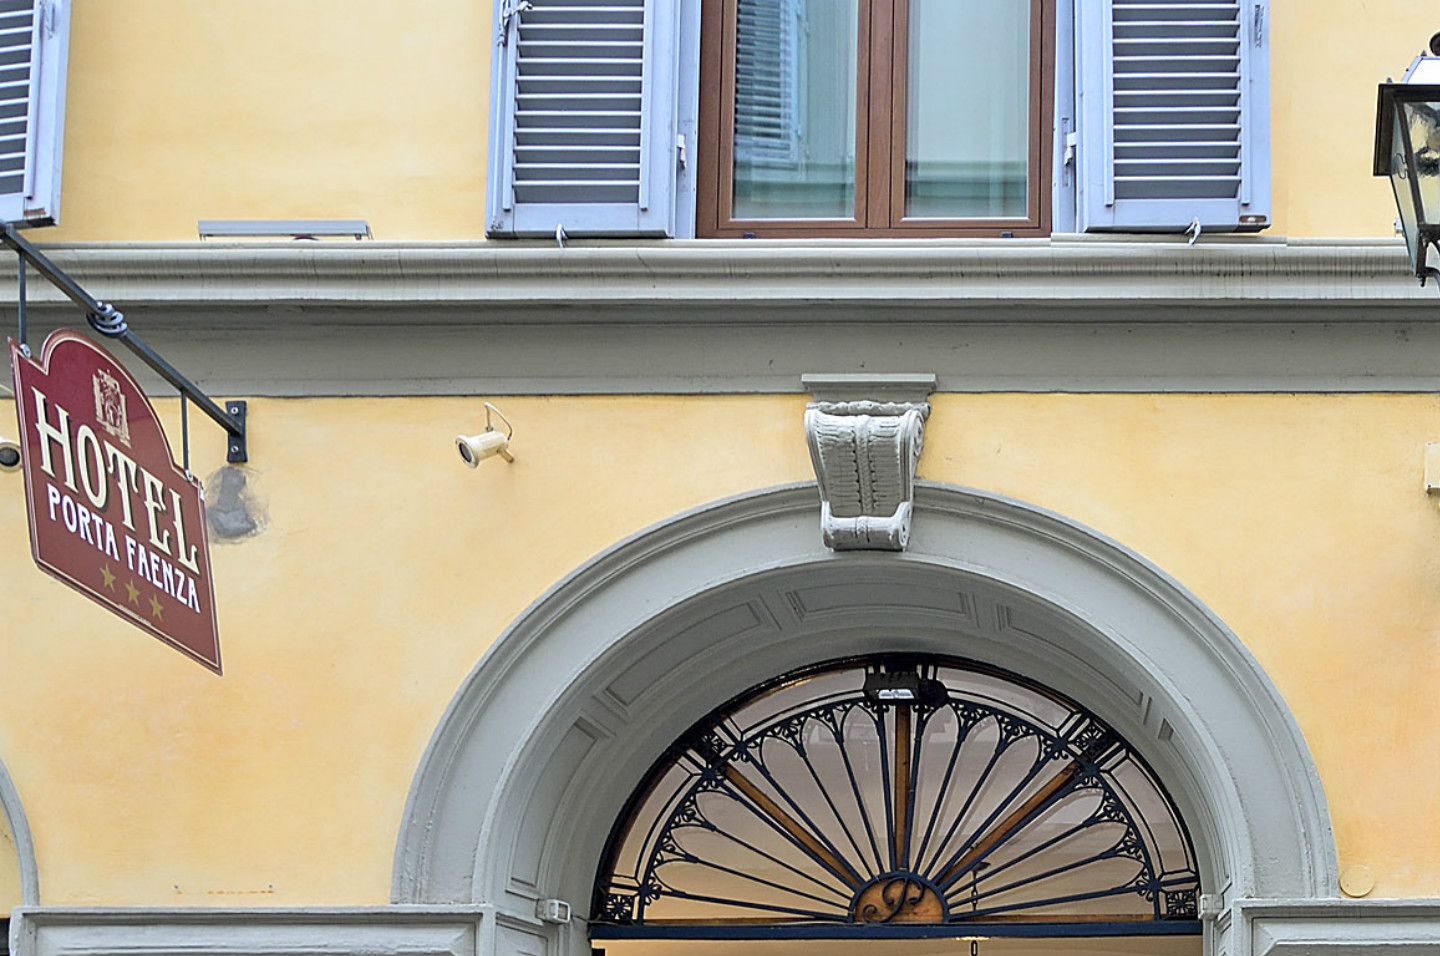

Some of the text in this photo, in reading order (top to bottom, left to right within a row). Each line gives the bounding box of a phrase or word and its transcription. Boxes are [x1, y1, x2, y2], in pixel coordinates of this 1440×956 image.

[31, 387, 200, 575] HOTEL
[47, 483, 201, 614] PORTA FAENZA
